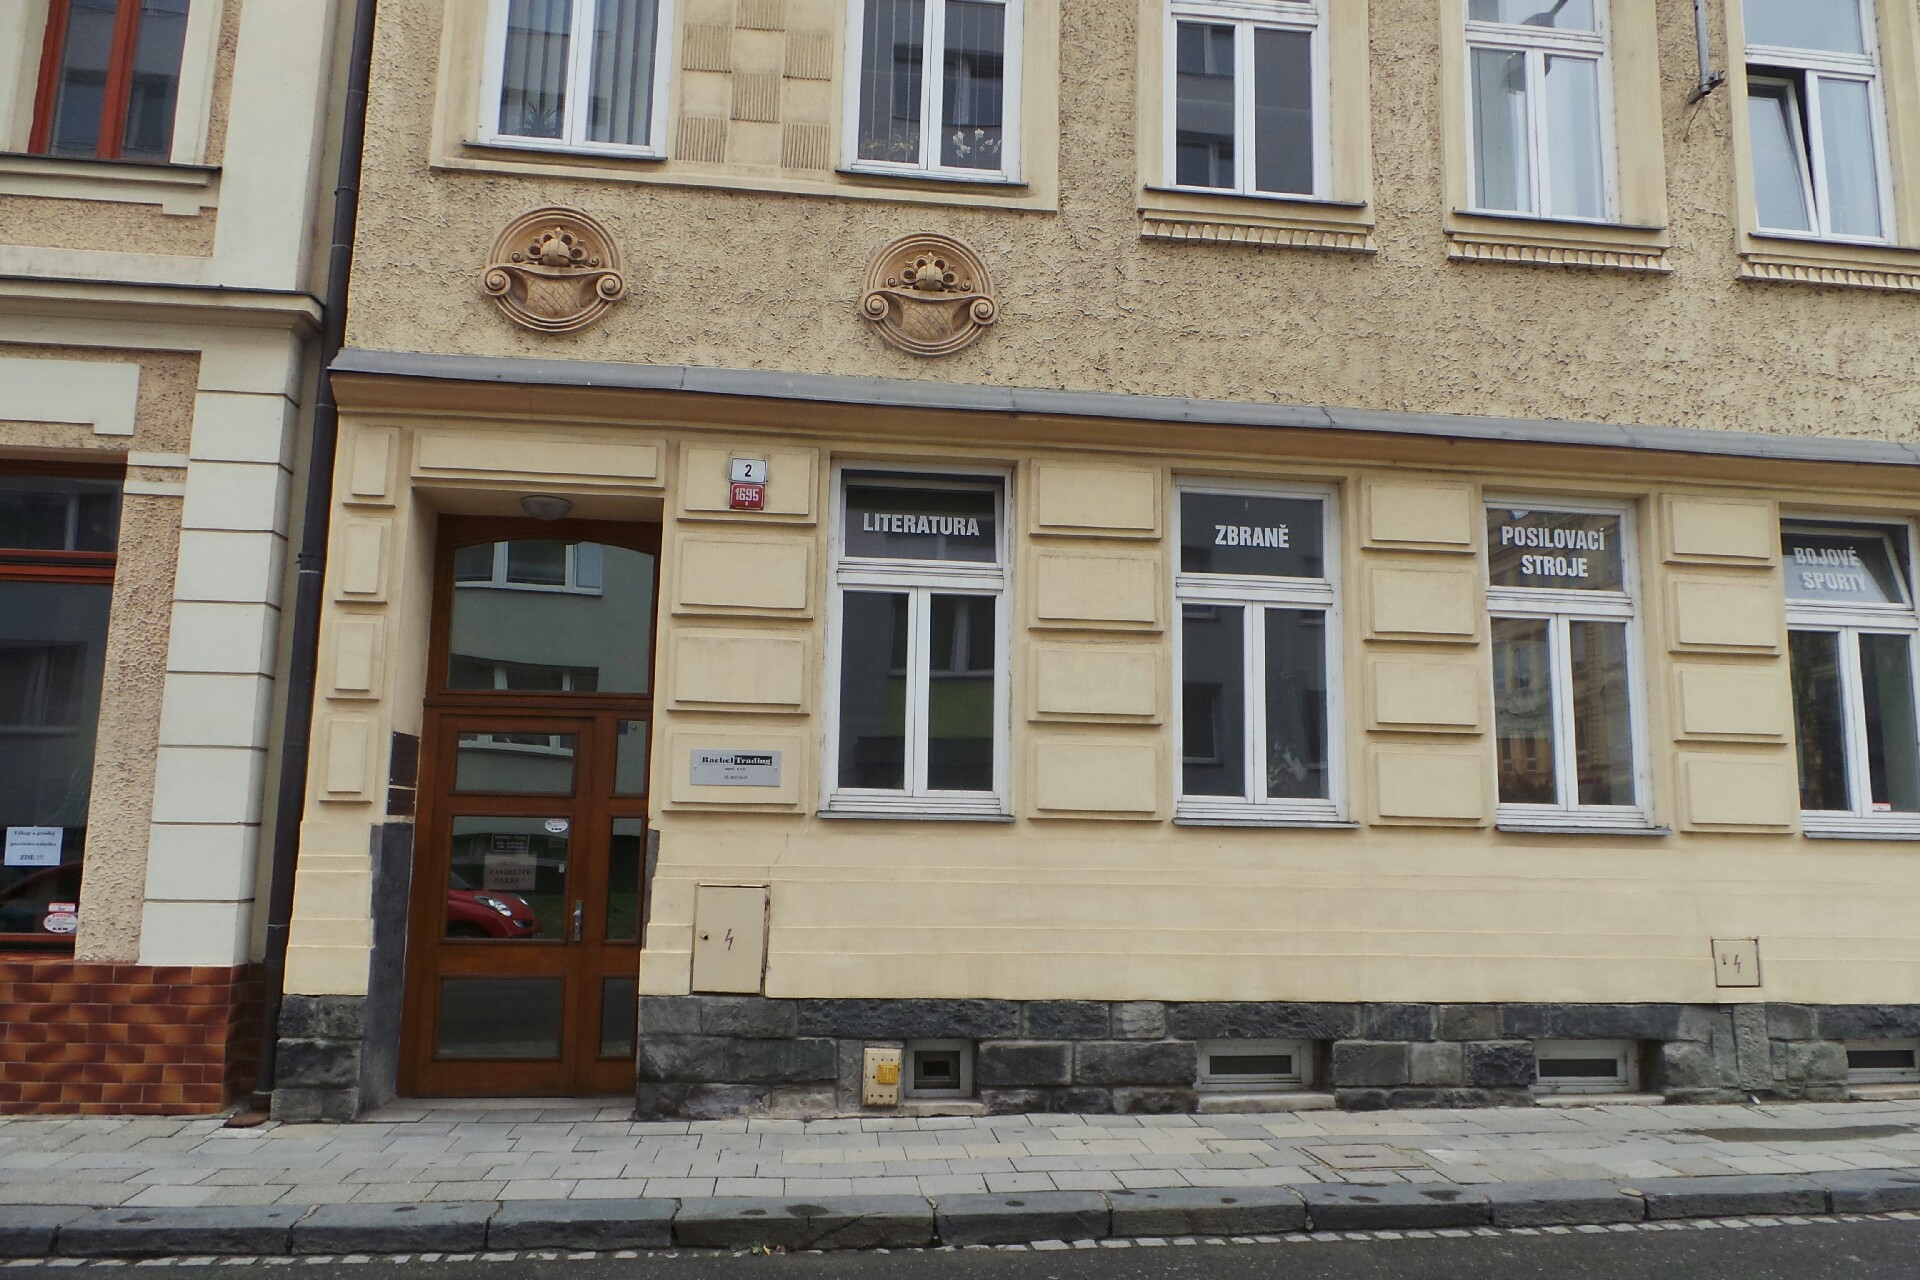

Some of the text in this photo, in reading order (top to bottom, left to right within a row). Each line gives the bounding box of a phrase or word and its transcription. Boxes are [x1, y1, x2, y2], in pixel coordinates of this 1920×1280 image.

[744, 463, 753, 478] 2
[735, 487, 760, 502] 1695
[863, 512, 980, 536] LITERATURA
[1214, 524, 1290, 548] ZBRANĚ
[1501, 525, 1605, 551] POSILOVACÍ
[1521, 554, 1589, 578] STROJE
[1793, 546, 1860, 566] BOJOVÉ
[1801, 571, 1866, 591] SPORTY
[735, 756, 771, 766] Trading
